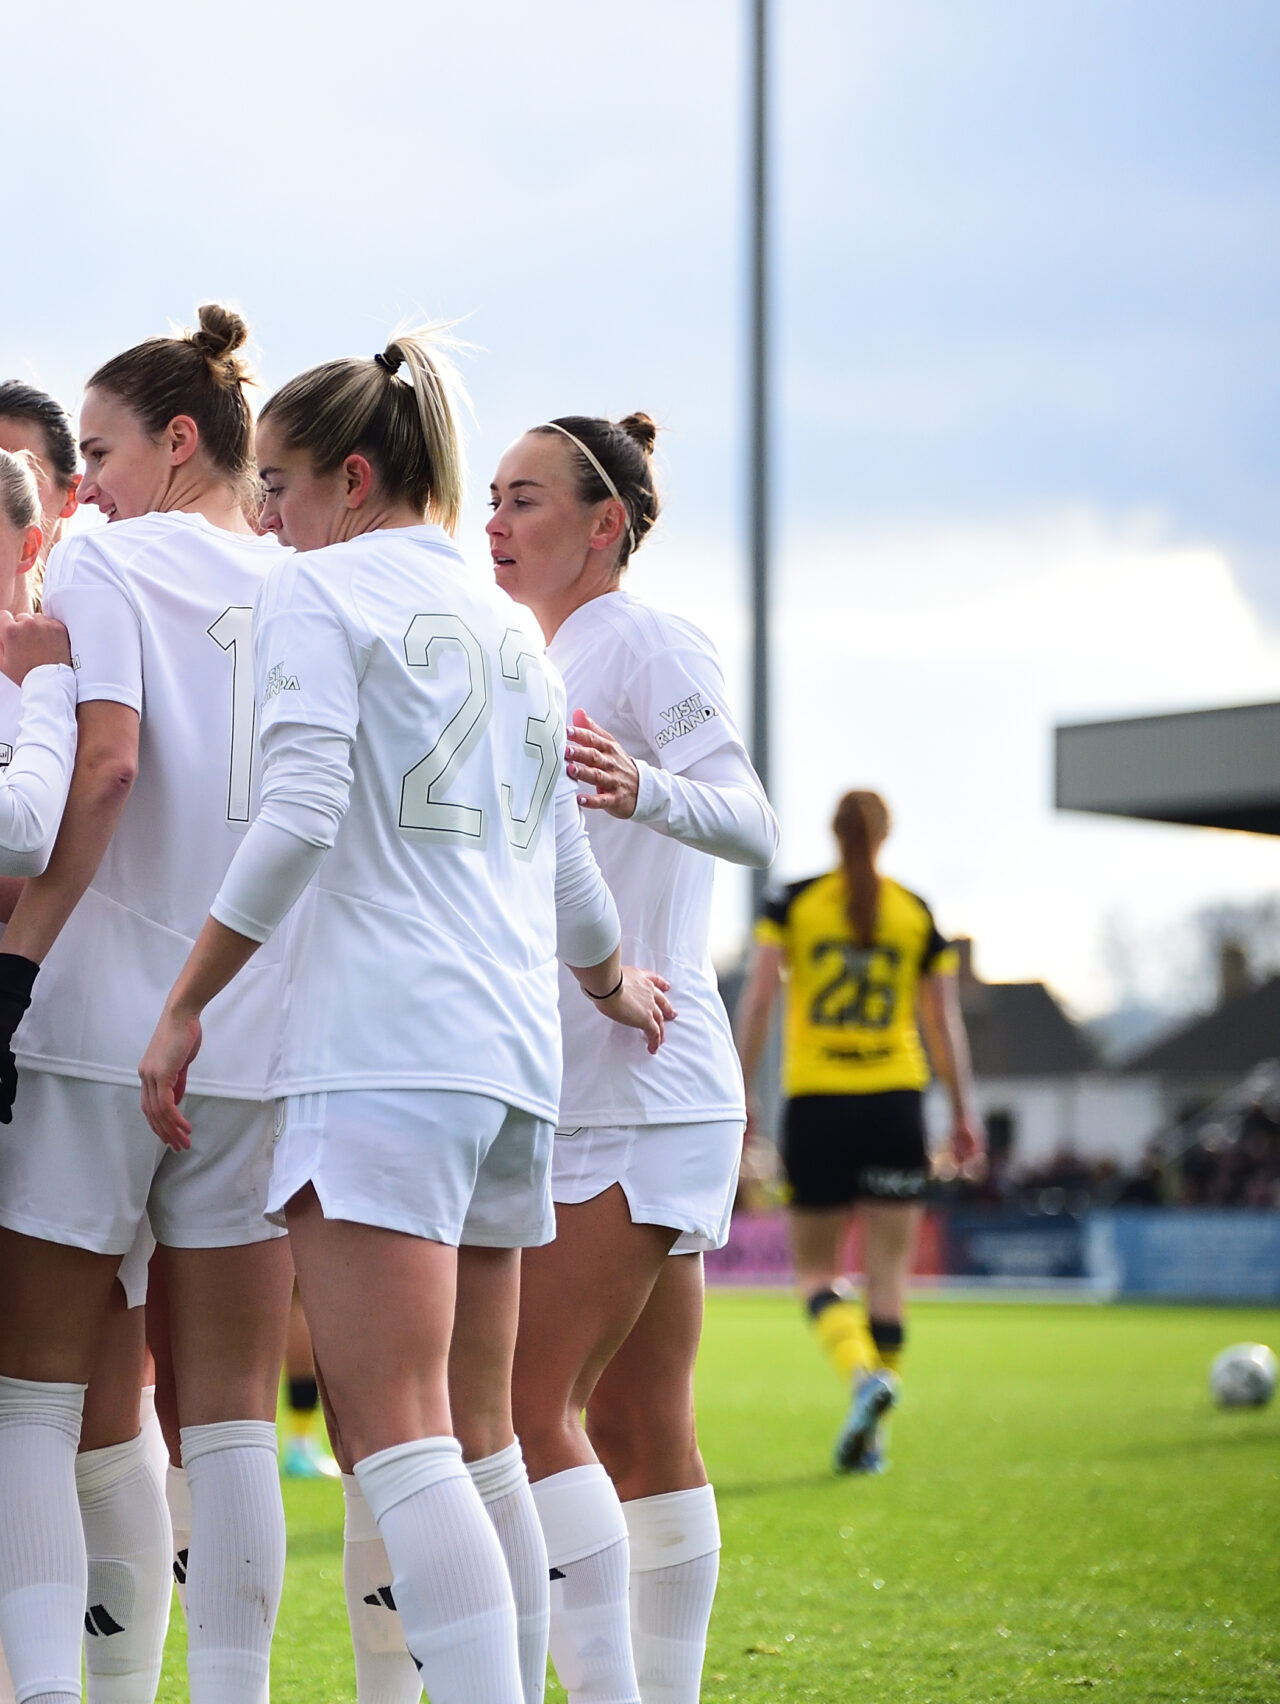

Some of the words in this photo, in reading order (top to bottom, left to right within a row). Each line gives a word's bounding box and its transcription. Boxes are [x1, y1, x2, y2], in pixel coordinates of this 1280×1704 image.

[399, 613, 560, 860] 23
[655, 706, 719, 749] RWAND
[659, 692, 703, 724] VISIT
[808, 938, 902, 1030] 26
